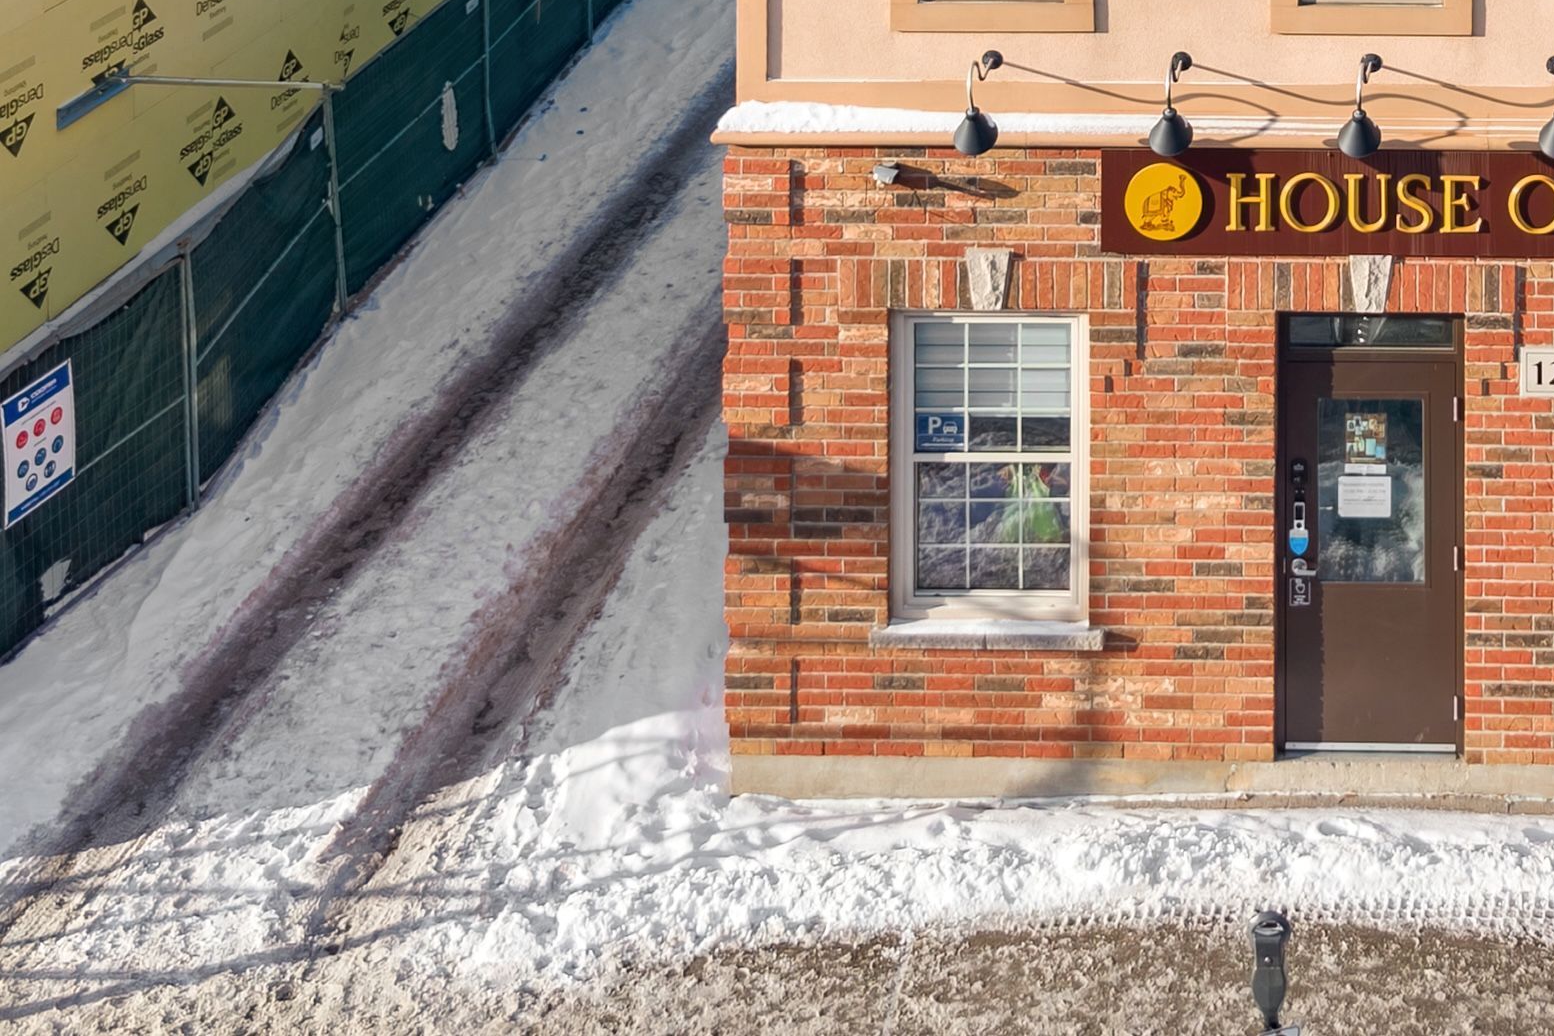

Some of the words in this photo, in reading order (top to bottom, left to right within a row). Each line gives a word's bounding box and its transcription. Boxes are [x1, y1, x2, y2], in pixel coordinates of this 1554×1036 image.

[283, 60, 296, 77] GP
[213, 106, 229, 126] GP
[6, 122, 28, 146] GP
[97, 175, 147, 219] DensGlass
[1224, 172, 1485, 235] HOUSE
[114, 213, 132, 236] GP
[30, 273, 48, 298] GP
[928, 416, 942, 435] P
